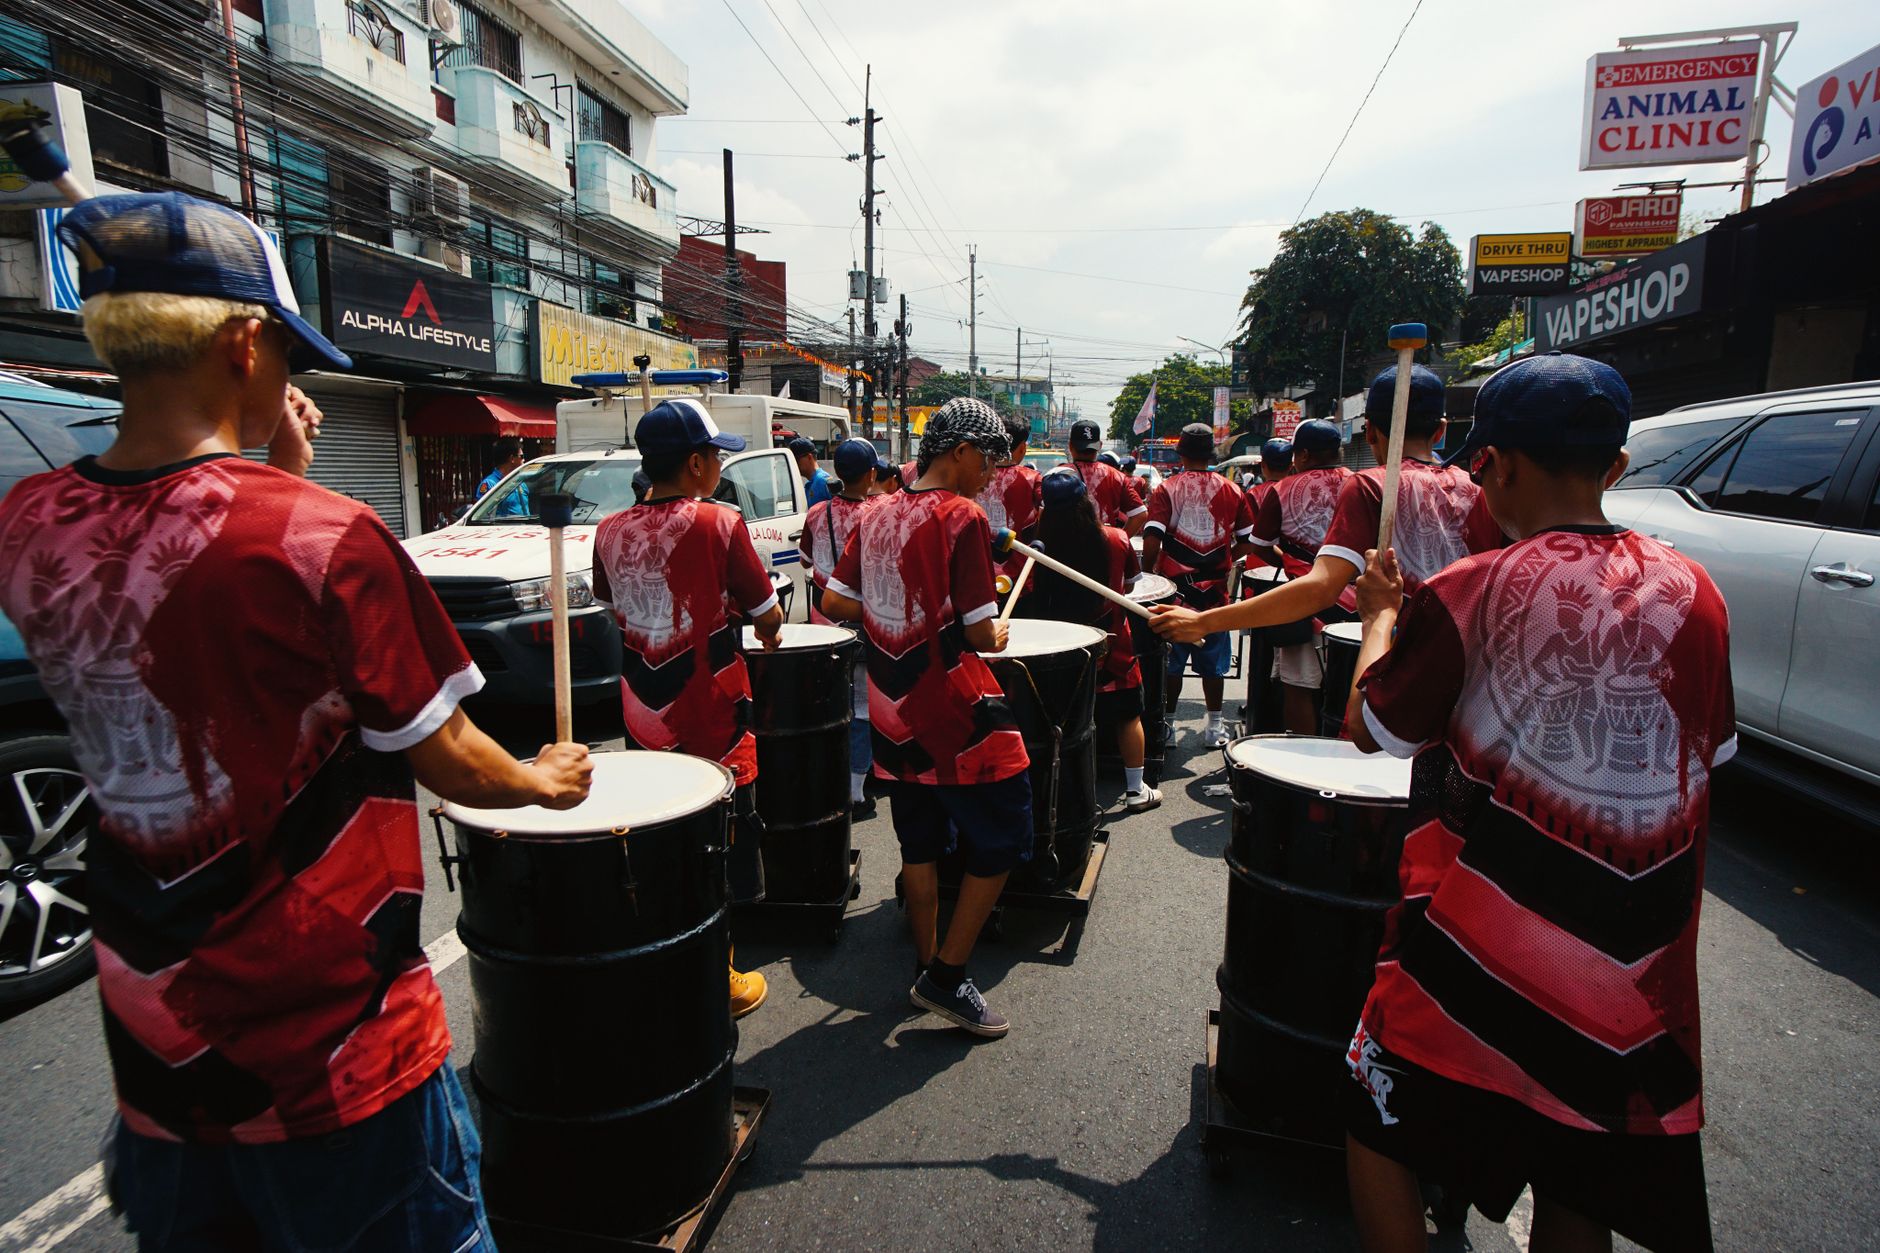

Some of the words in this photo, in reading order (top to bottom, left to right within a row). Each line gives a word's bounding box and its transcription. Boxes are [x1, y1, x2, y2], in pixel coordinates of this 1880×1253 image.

[1620, 56, 1755, 84] EMERGENCY
[1847, 66, 1880, 110] V
[1600, 86, 1746, 120] ANIMAL
[1598, 117, 1741, 152] CLINIC
[1853, 115, 1880, 145] A
[1613, 196, 1678, 218] JARO
[1609, 219, 1677, 228] PAWNSHOP
[1482, 244, 1523, 256] DRIVE
[1528, 243, 1565, 254] THRU
[1585, 238, 1624, 250] HIGHEST
[1626, 235, 1675, 249] APPRAISAL
[1480, 268, 1564, 283] VAPESHOP
[1546, 263, 1690, 347] VAPESHOP
[341, 310, 406, 337] ALPHA
[409, 323, 491, 353] LIFESTYLE
[545, 325, 618, 372] Mila's
[1275, 414, 1300, 423] KFC
[750, 528, 761, 540] LA
[762, 528, 783, 543] LOMA
[416, 547, 509, 560] 1541
[529, 619, 584, 643] 151
